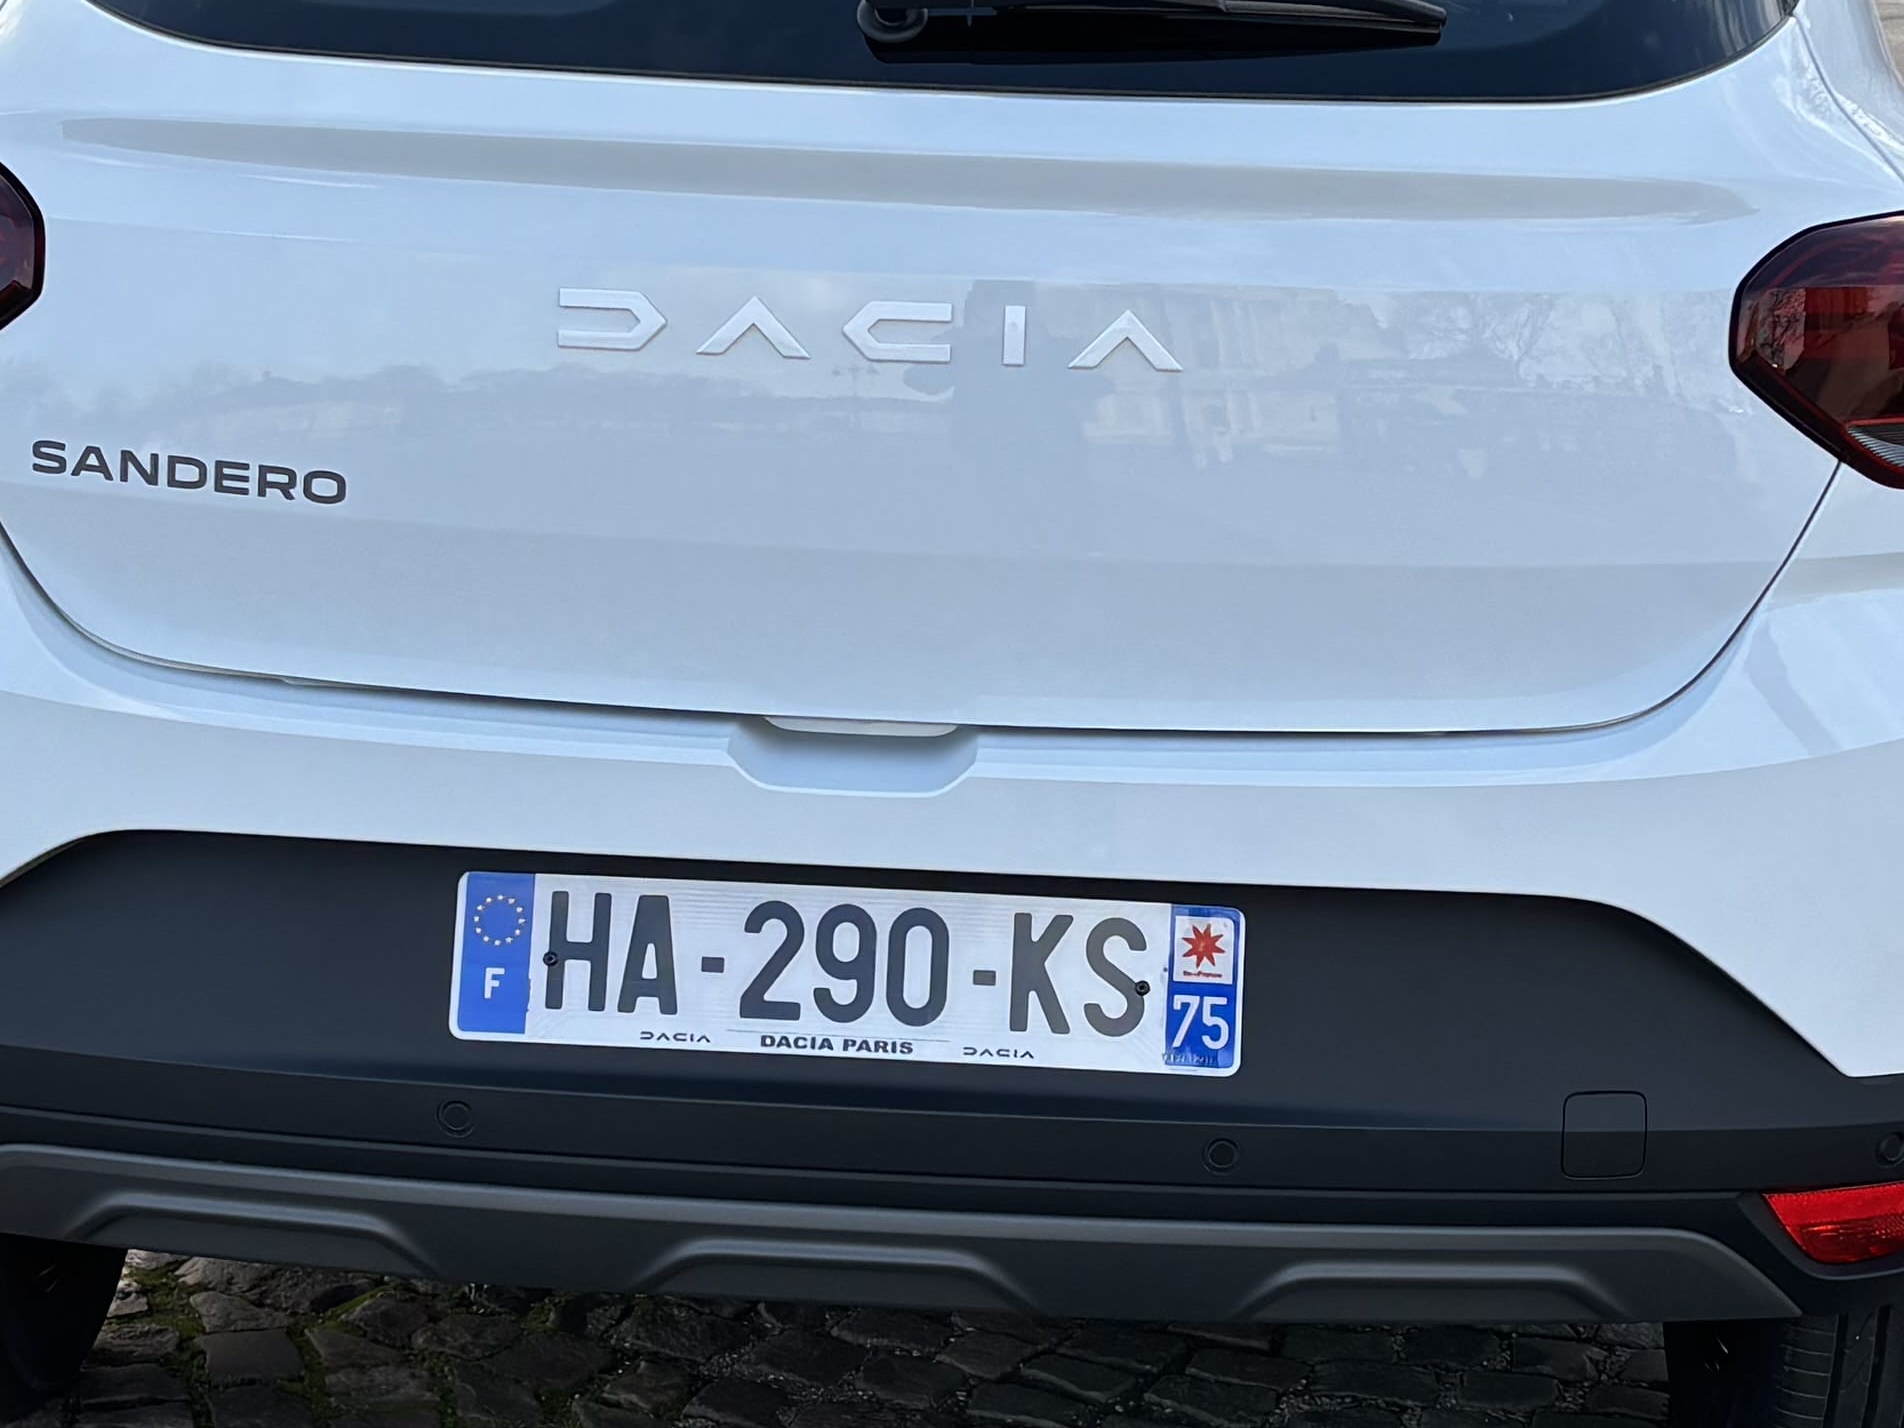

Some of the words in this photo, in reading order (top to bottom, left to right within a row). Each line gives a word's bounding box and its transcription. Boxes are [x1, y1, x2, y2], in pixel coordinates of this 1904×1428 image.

[556, 287, 1184, 373] DACIA
[32, 439, 347, 505] SANDERO
[484, 967, 506, 999] F
[543, 891, 1151, 1039] HA-290-KS
[639, 1031, 711, 1044] DACIA
[1171, 995, 1229, 1050] 75
[760, 1034, 834, 1051] DACIA
[842, 1038, 914, 1055] PARIS
[963, 1046, 1034, 1060] DACIA
